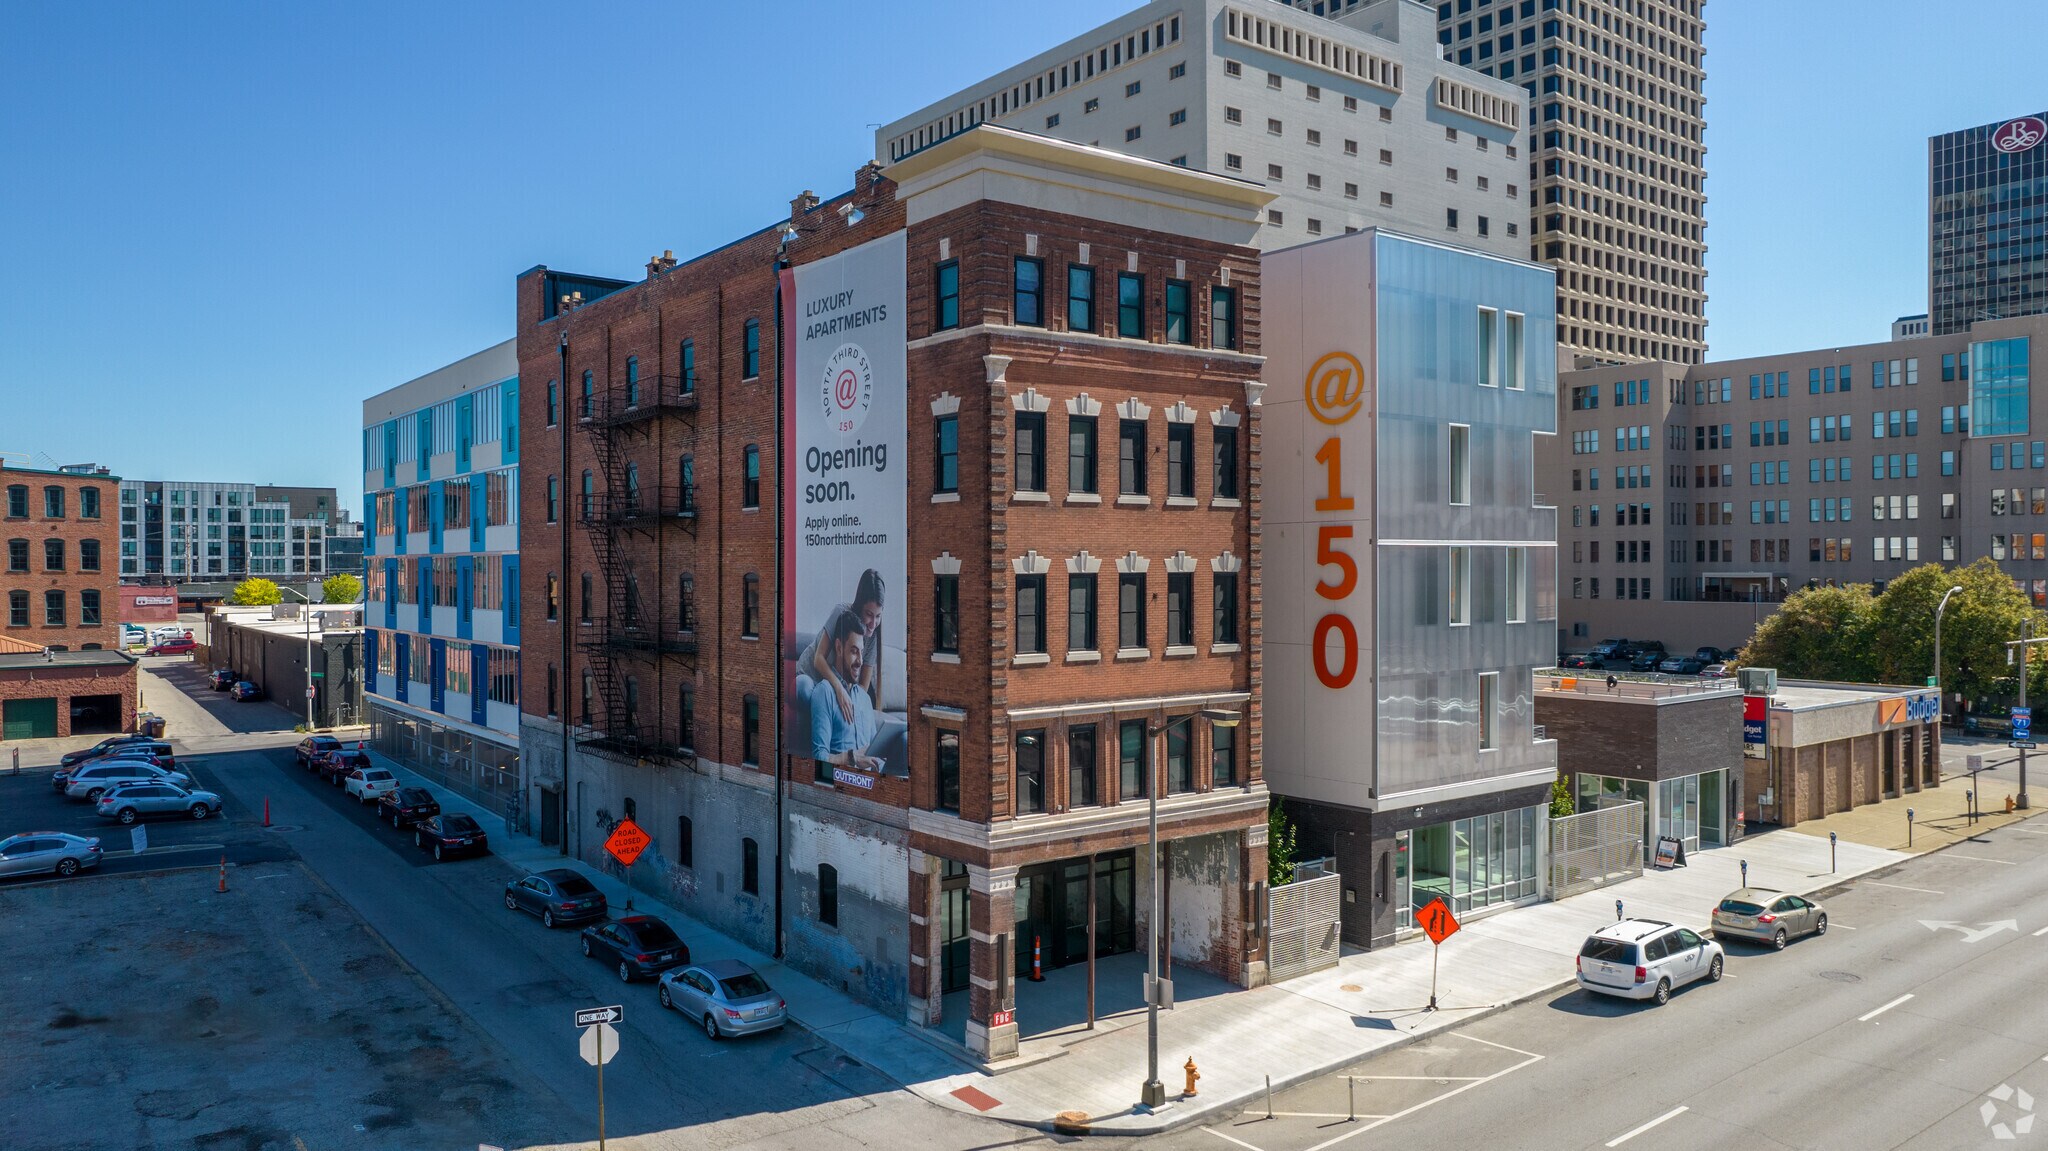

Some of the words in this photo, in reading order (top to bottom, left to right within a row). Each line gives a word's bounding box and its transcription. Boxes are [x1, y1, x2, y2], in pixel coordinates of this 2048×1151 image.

[806, 289, 854, 318] LUXURY
[806, 304, 887, 341] APARTMENTS
[823, 367, 833, 418] NORTH
[833, 347, 859, 365] THIRD
[859, 357, 871, 412] STREET
[839, 420, 853, 432] 150
[806, 439, 888, 478] Opening
[805, 480, 856, 504] soon.
[805, 515, 829, 531] Apply
[832, 514, 862, 528] online.
[805, 532, 887, 547] 150norththird.com
[1744, 725, 1762, 734] dget
[834, 770, 872, 787] OUTFRONT
[614, 837, 641, 846] CLOSED
[618, 829, 637, 837] ROAD
[617, 846, 640, 855] AHEAD
